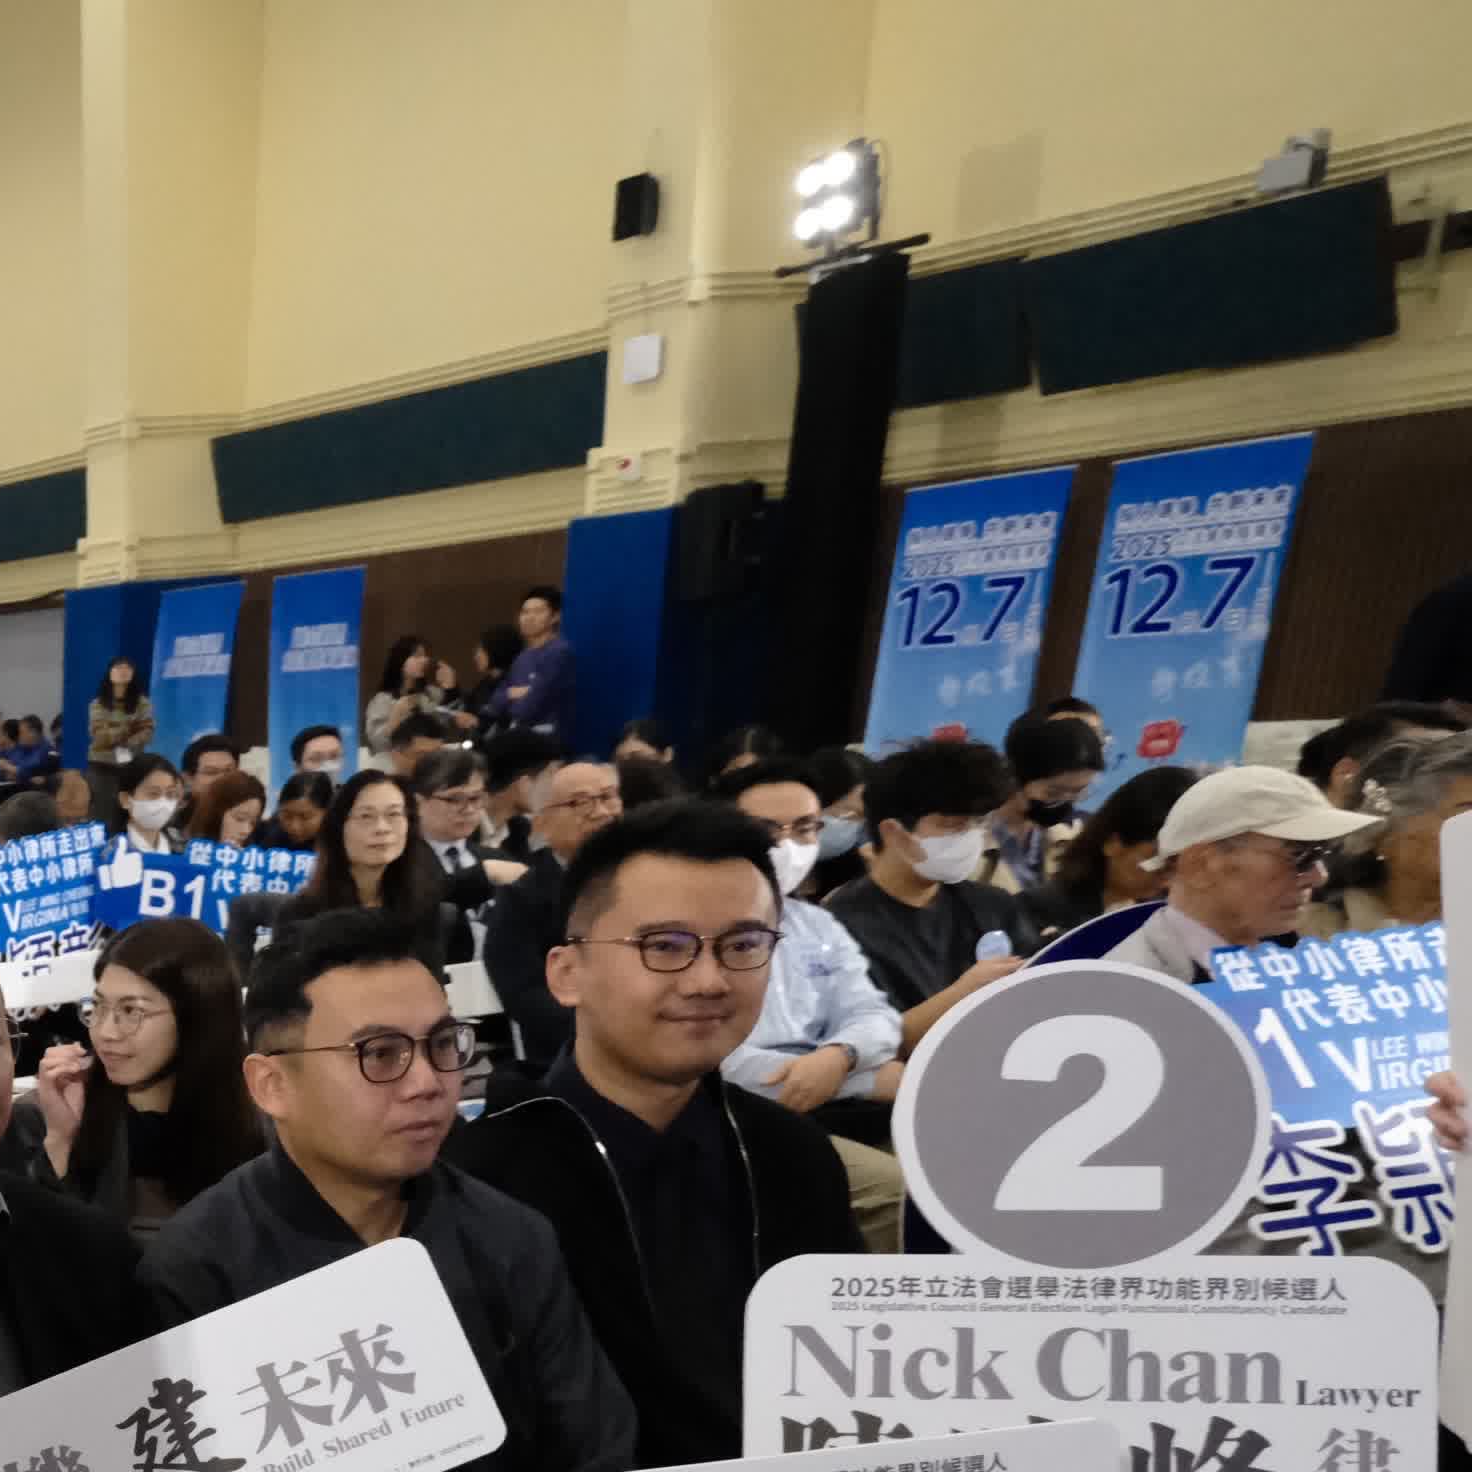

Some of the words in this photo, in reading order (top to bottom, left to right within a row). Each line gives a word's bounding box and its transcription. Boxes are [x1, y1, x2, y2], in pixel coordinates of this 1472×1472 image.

[139, 869, 206, 920] B1
[994, 1014, 1165, 1211] 2
[831, 1276, 1347, 1302] 2025年立法會選舉法律界功能界別候選人
[782, 1322, 1014, 1402] Nick
[1034, 1325, 1285, 1405] Chan
[1296, 1378, 1421, 1412] Lawyer
[321, 1418, 393, 1460] Shared
[398, 1391, 466, 1429] Future
